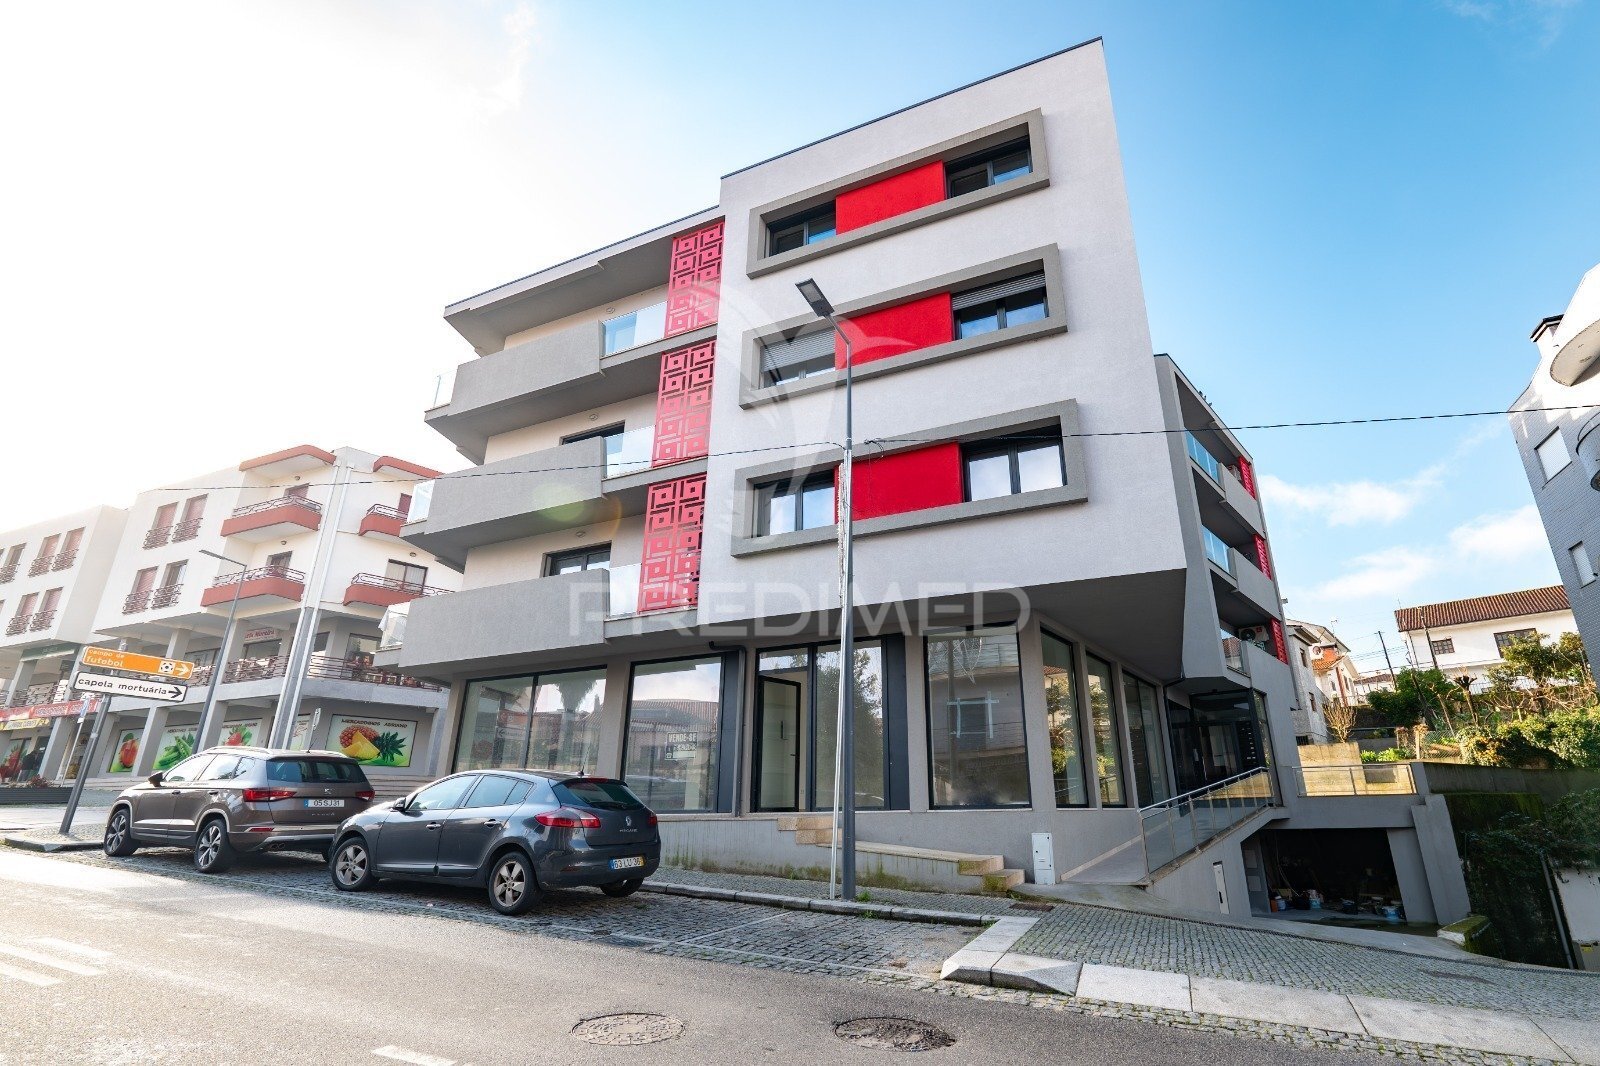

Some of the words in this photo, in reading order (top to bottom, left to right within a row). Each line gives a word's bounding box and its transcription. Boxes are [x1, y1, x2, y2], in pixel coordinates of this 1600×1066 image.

[88, 648, 113, 657] campo
[78, 678, 113, 689] capela
[118, 683, 167, 695] mortuária
